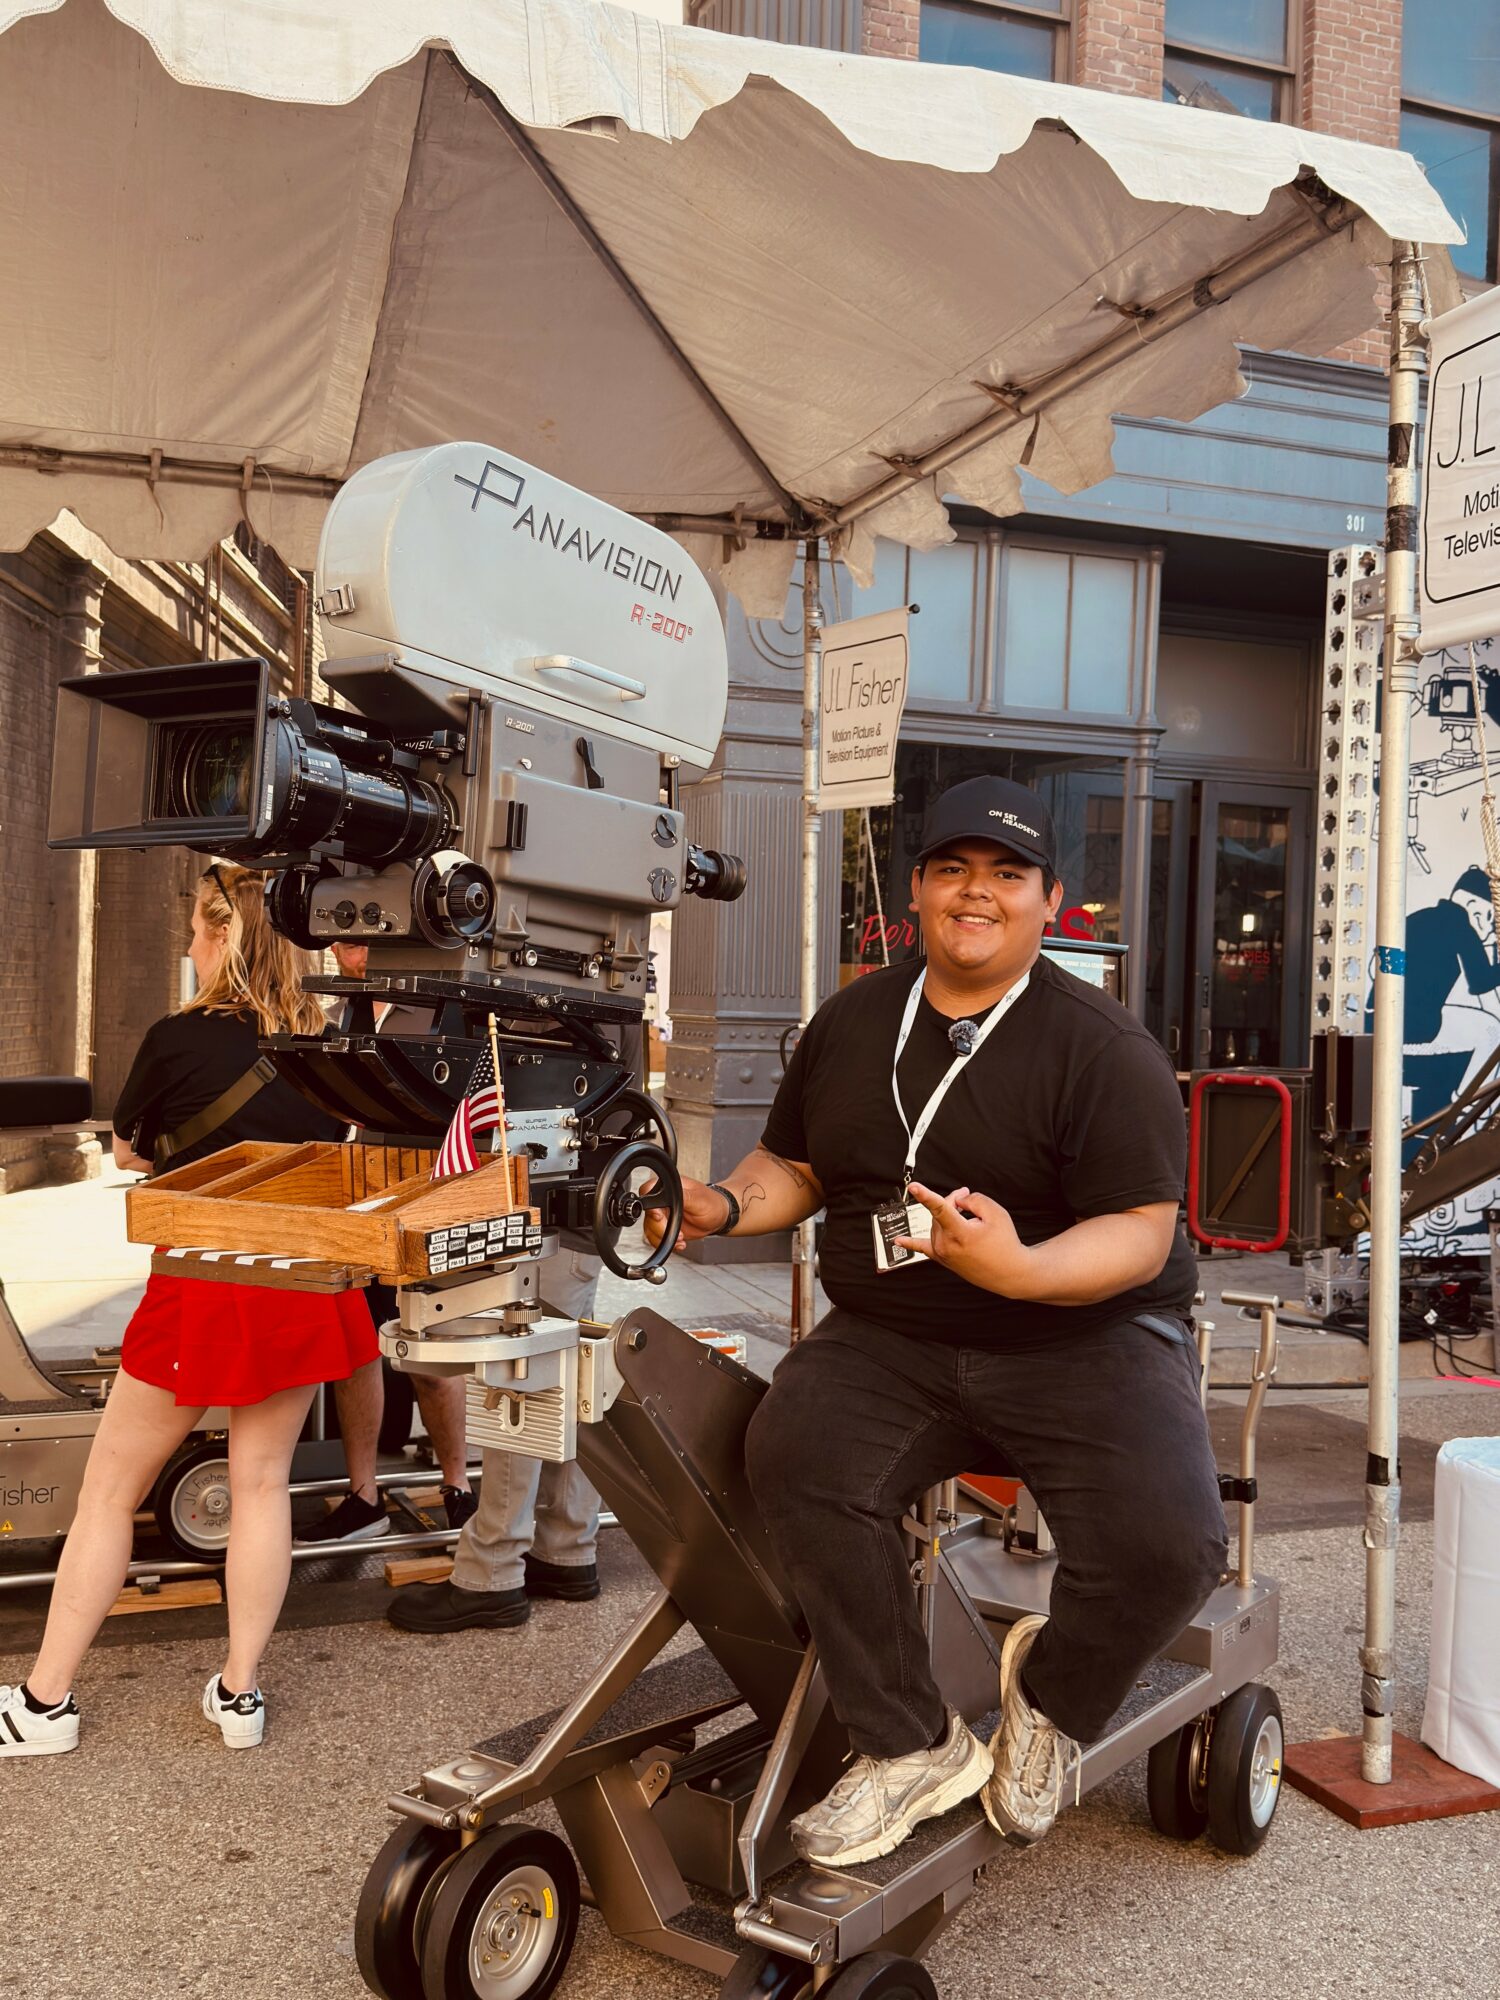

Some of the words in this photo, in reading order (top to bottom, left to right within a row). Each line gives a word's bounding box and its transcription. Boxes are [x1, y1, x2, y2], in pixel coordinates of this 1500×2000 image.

[453, 460, 682, 602] PANAVISION
[1346, 513, 1365, 532] 301
[848, 662, 901, 709] Fisher
[832, 729, 851, 742] Motion
[853, 726, 875, 739] Picture
[876, 722, 882, 736] &
[827, 749, 852, 763] Television
[854, 742, 889, 761] Equipment
[988, 809, 1003, 818] ON
[1004, 812, 1018, 821] SET
[859, 913, 916, 955] Per
[192, 1472, 228, 1489] Fisher
